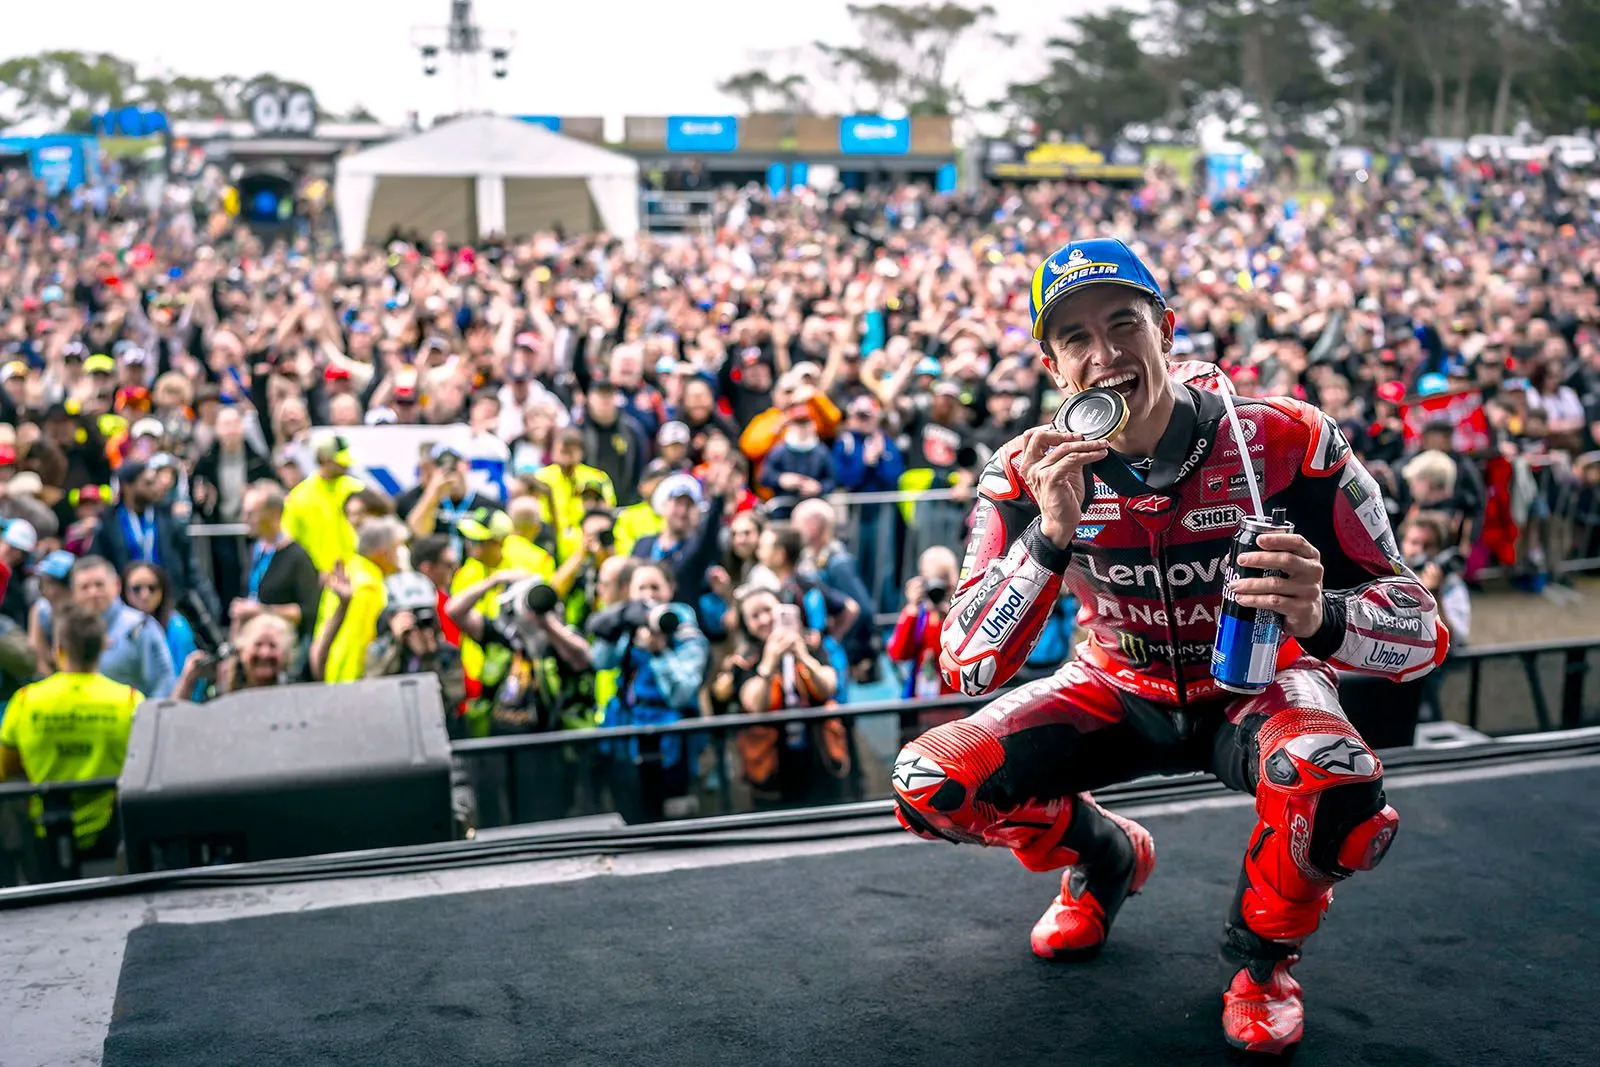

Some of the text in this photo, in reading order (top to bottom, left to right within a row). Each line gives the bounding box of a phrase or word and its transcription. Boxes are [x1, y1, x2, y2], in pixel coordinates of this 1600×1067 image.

[1044, 266, 1118, 303] MICHELIN
[1223, 443, 1265, 457] morola
[1230, 474, 1261, 485] Leno
[1192, 508, 1240, 527] SHOEI
[1074, 527, 1100, 539] SAP
[961, 573, 1000, 627] Lenovo
[981, 584, 1026, 639] Unipol
[1375, 611, 1420, 632] Lenovo
[1369, 641, 1412, 669] Unipol
